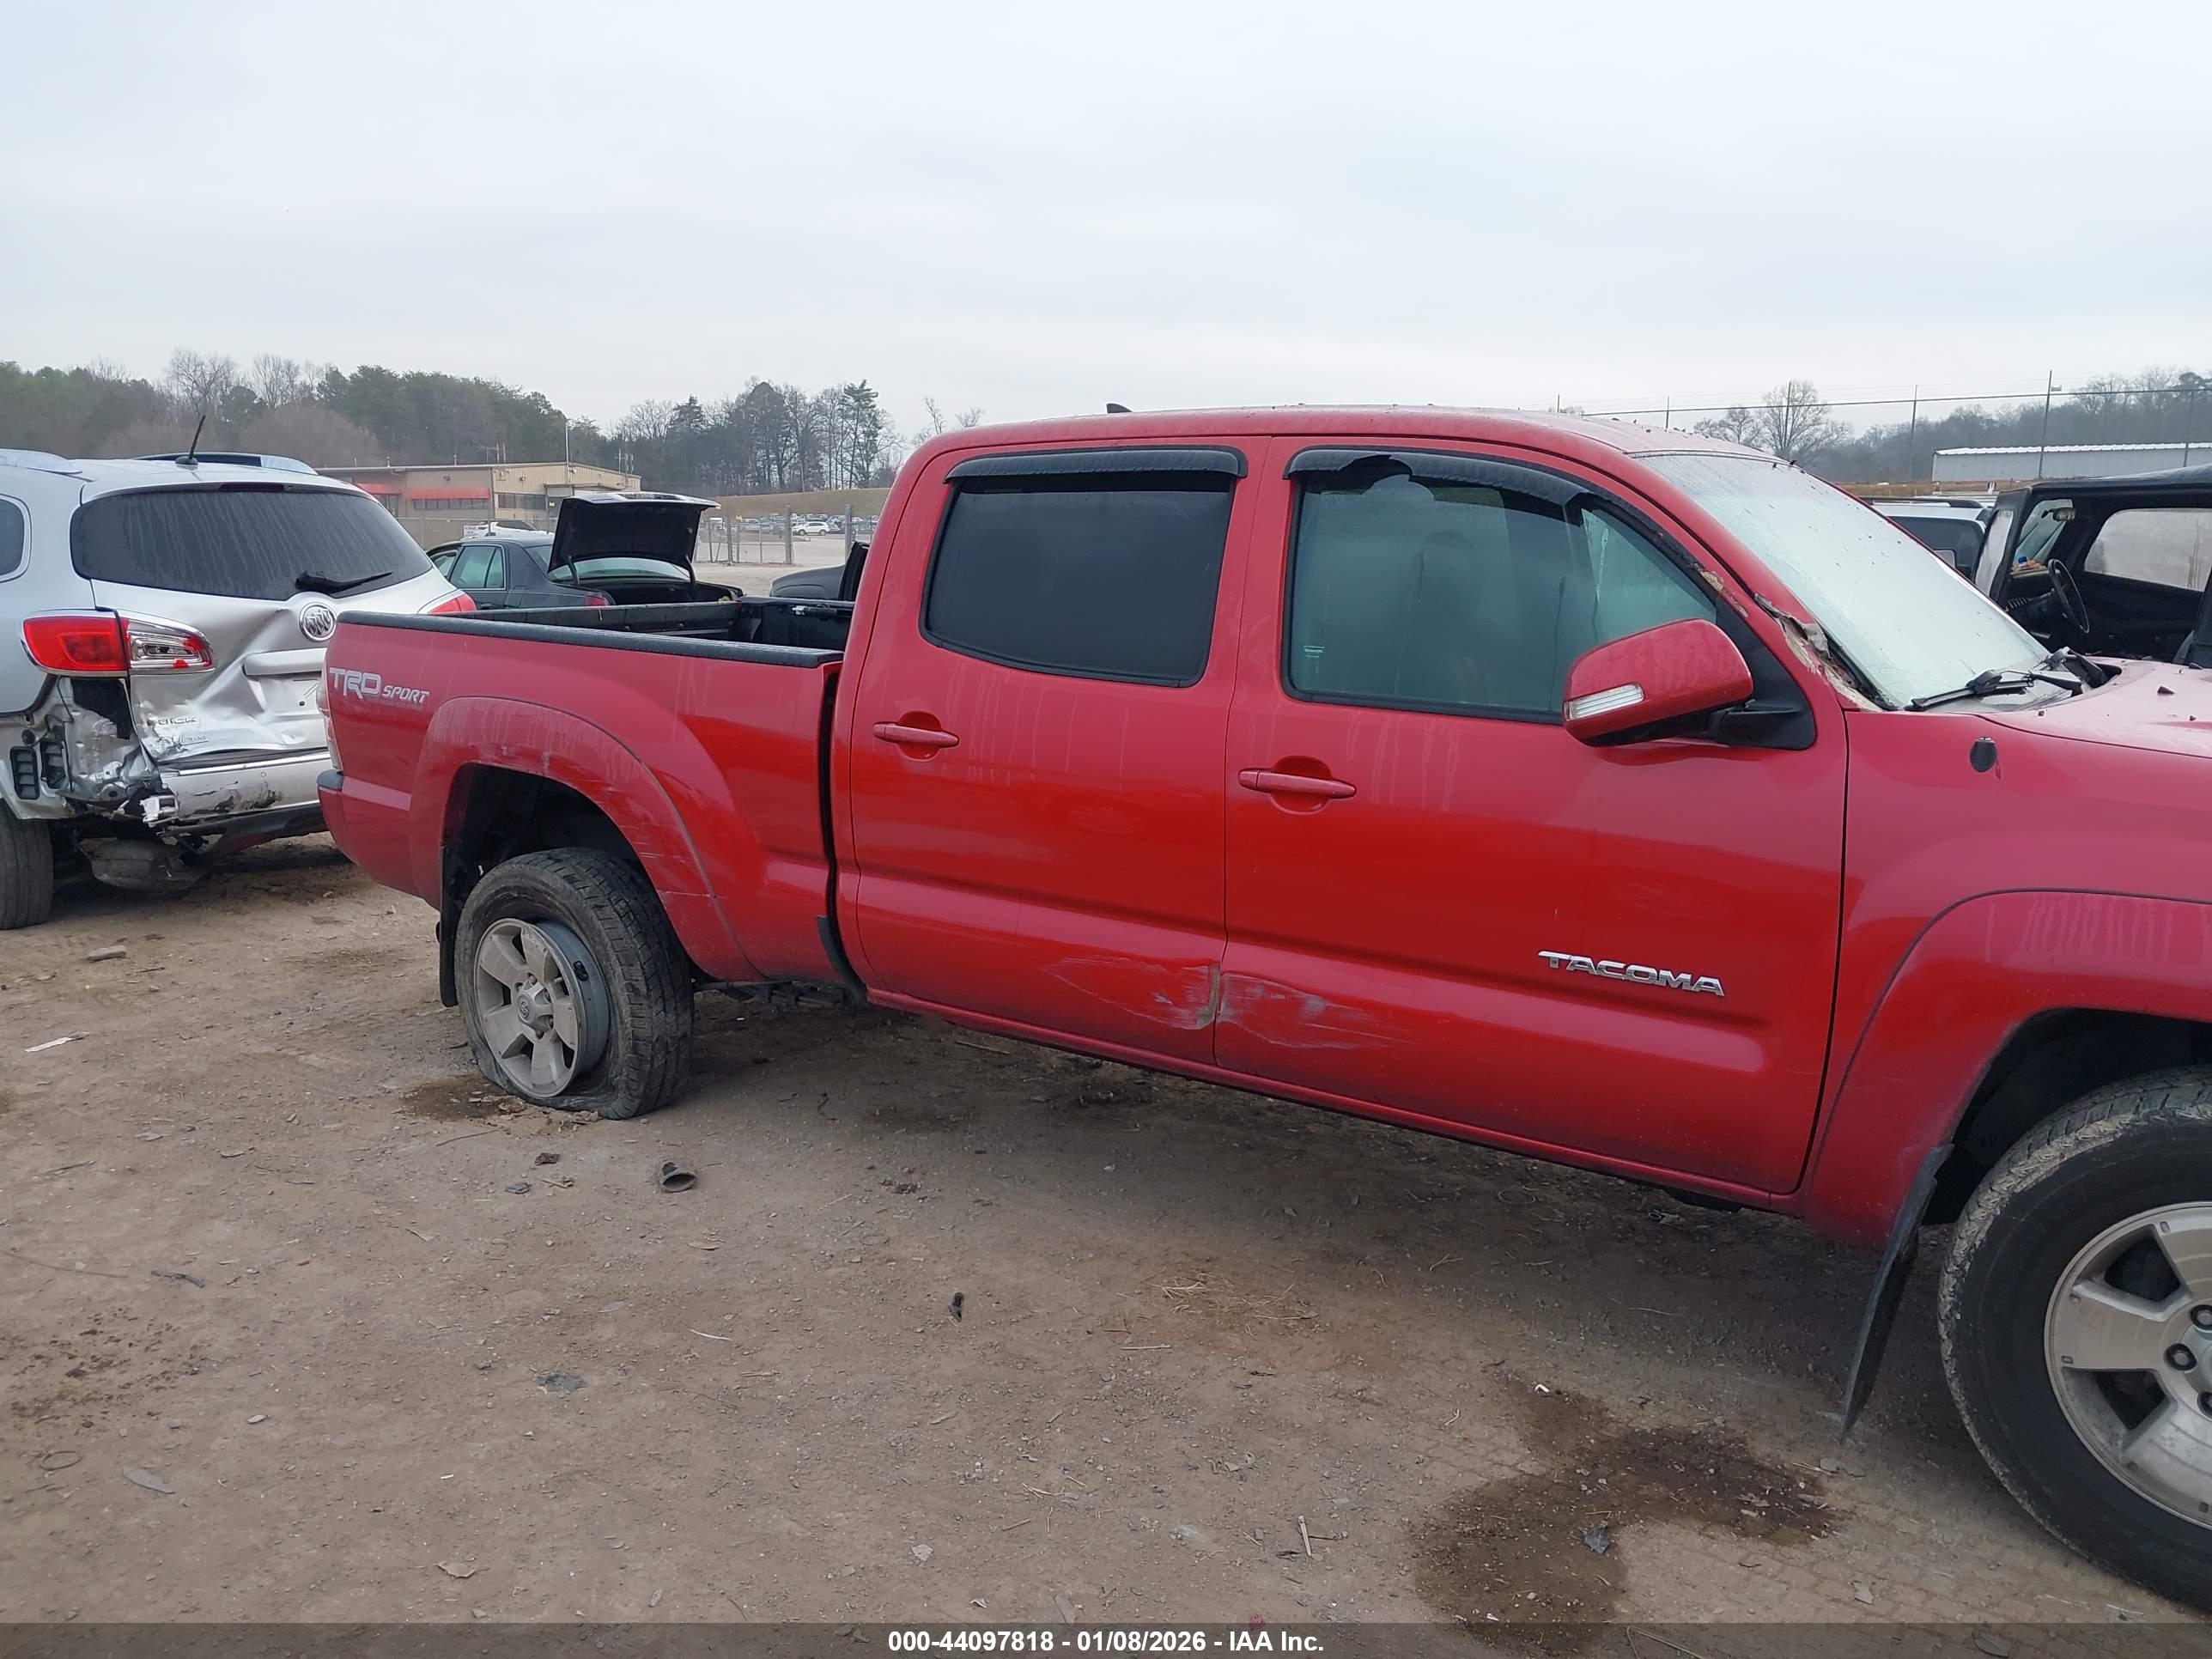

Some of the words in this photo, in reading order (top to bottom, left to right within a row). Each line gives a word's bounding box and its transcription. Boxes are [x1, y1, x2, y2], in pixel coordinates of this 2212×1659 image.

[329, 666, 381, 700] TRD
[382, 684, 430, 703] SPORT
[1538, 951, 1725, 996] TACOMA
